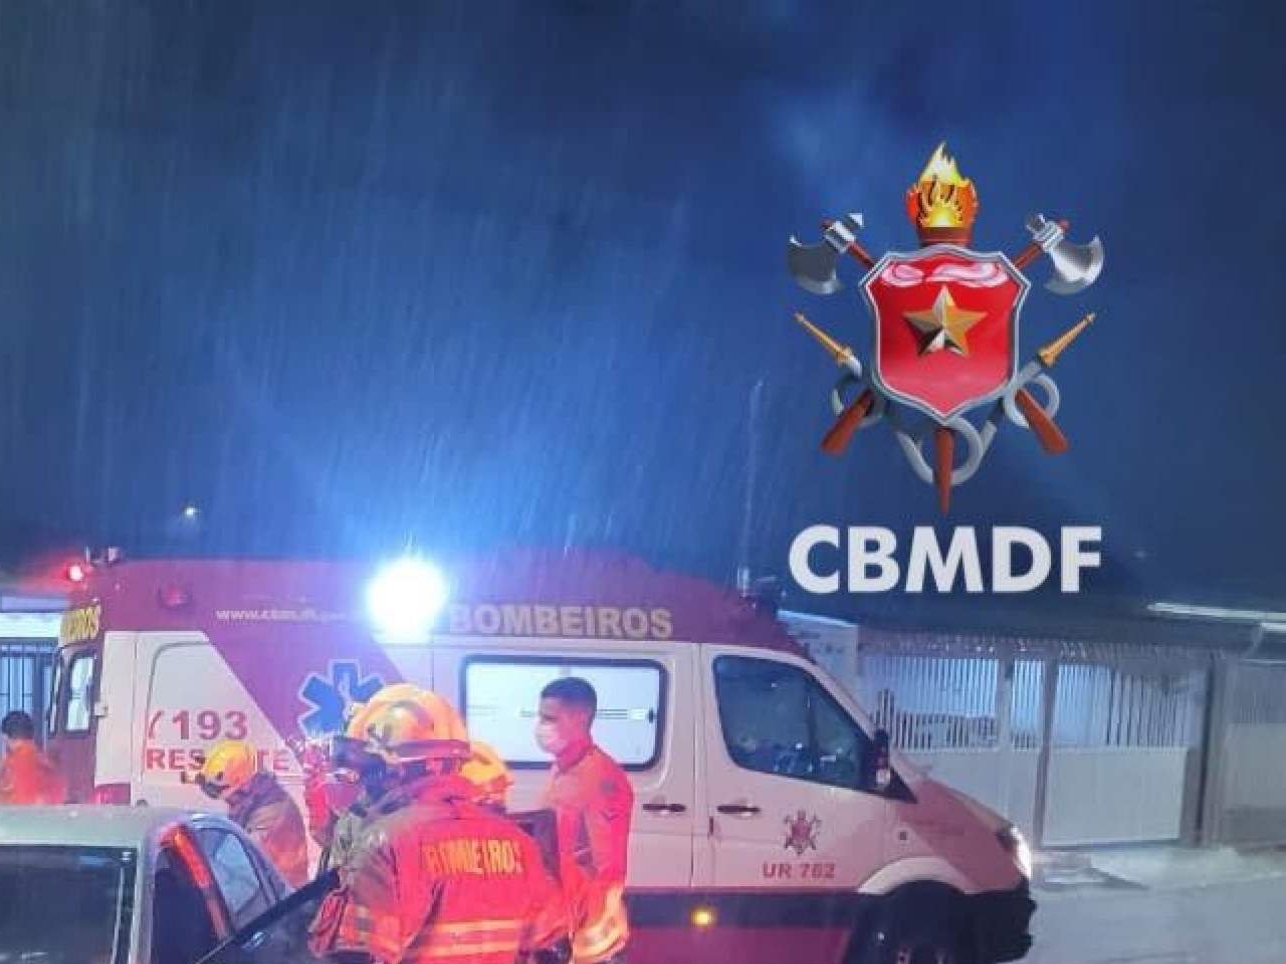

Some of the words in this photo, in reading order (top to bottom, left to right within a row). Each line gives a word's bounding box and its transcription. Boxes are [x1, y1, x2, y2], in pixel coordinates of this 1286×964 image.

[449, 603, 674, 638] BOMBEIROS
[146, 748, 291, 770] RESTE
[762, 862, 792, 879] UR
